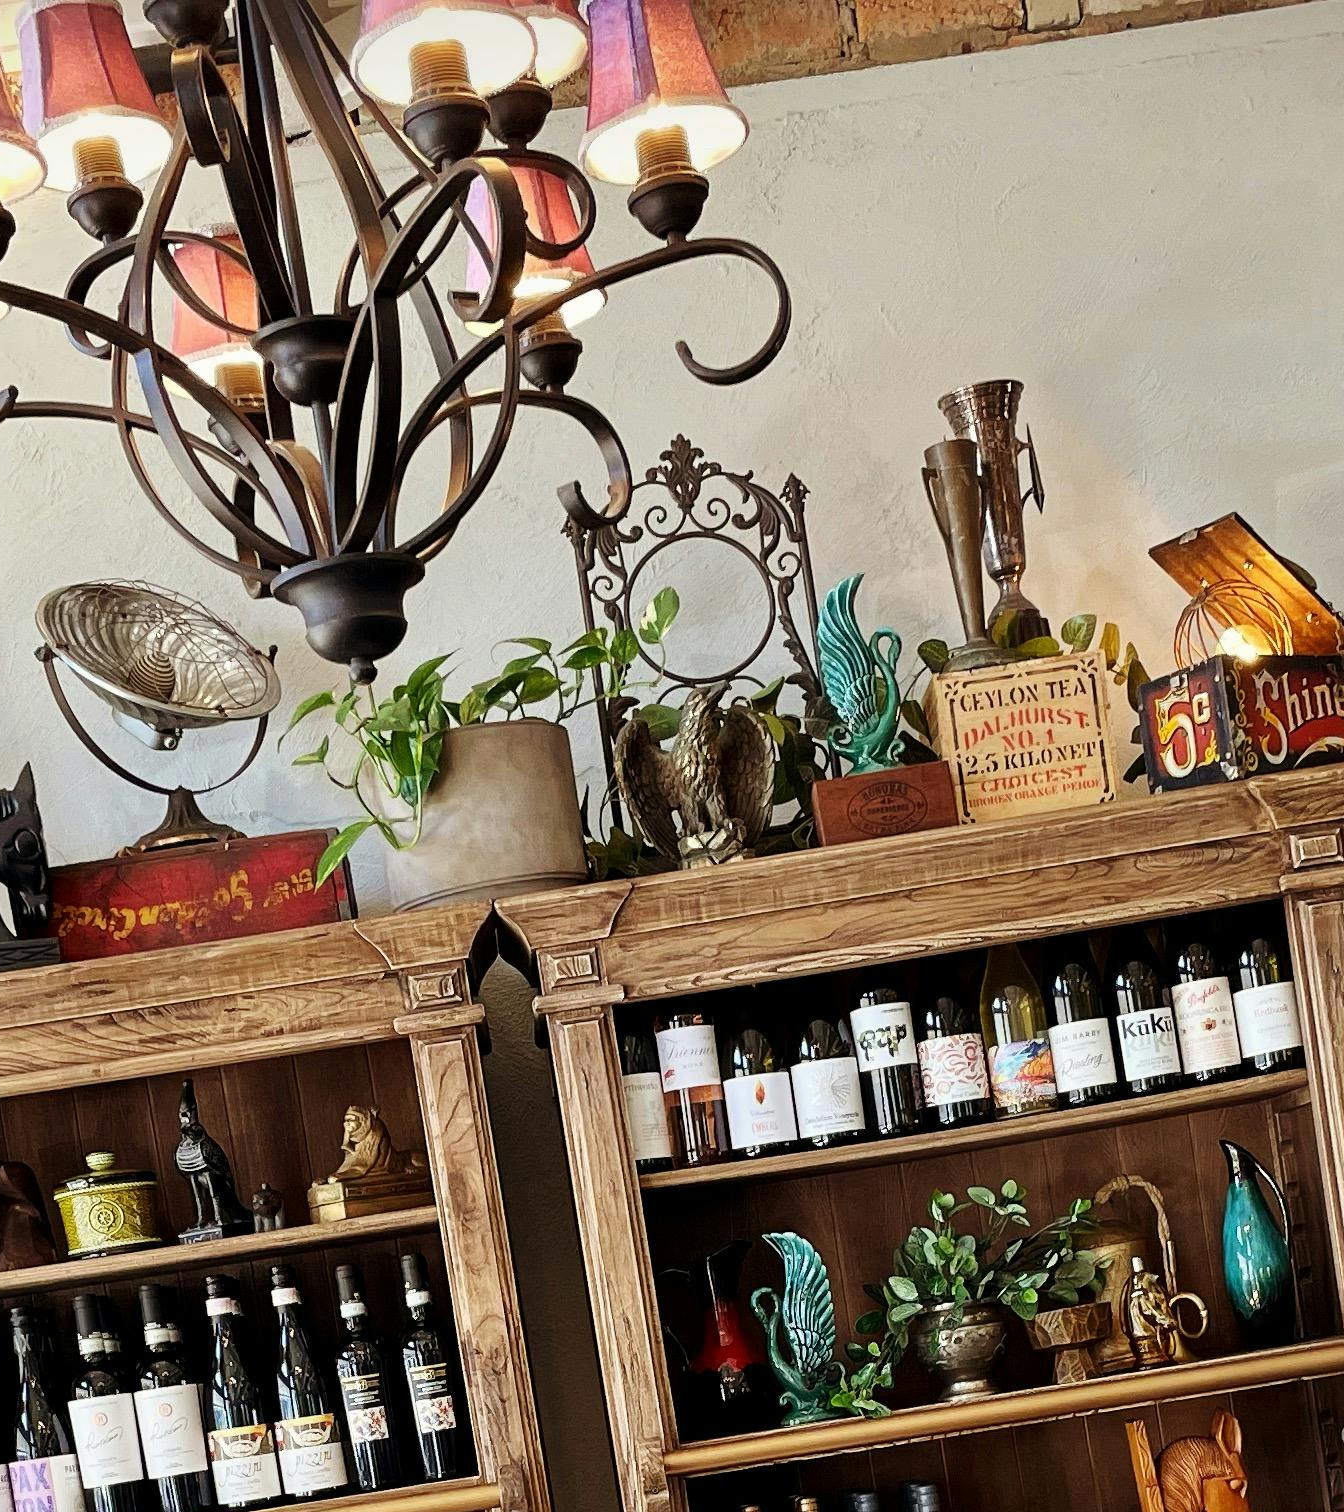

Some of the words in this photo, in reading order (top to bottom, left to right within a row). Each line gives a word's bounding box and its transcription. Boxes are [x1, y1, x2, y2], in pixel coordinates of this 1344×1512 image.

[960, 684, 1039, 713] CEYLON
[1045, 677, 1087, 699] TEA
[1002, 730, 1041, 751] NO.
[1046, 728, 1055, 745] 1
[965, 753, 999, 776] 2.5
[1004, 749, 1053, 770] KILO
[1056, 741, 1097, 762] NET
[981, 765, 1087, 793] CHOICEST
[969, 793, 1013, 809] BROKEN
[1014, 785, 1058, 800] ORANGE
[1073, 1029, 1101, 1041] BARRY
[624, 1083, 659, 1095] rthworks
